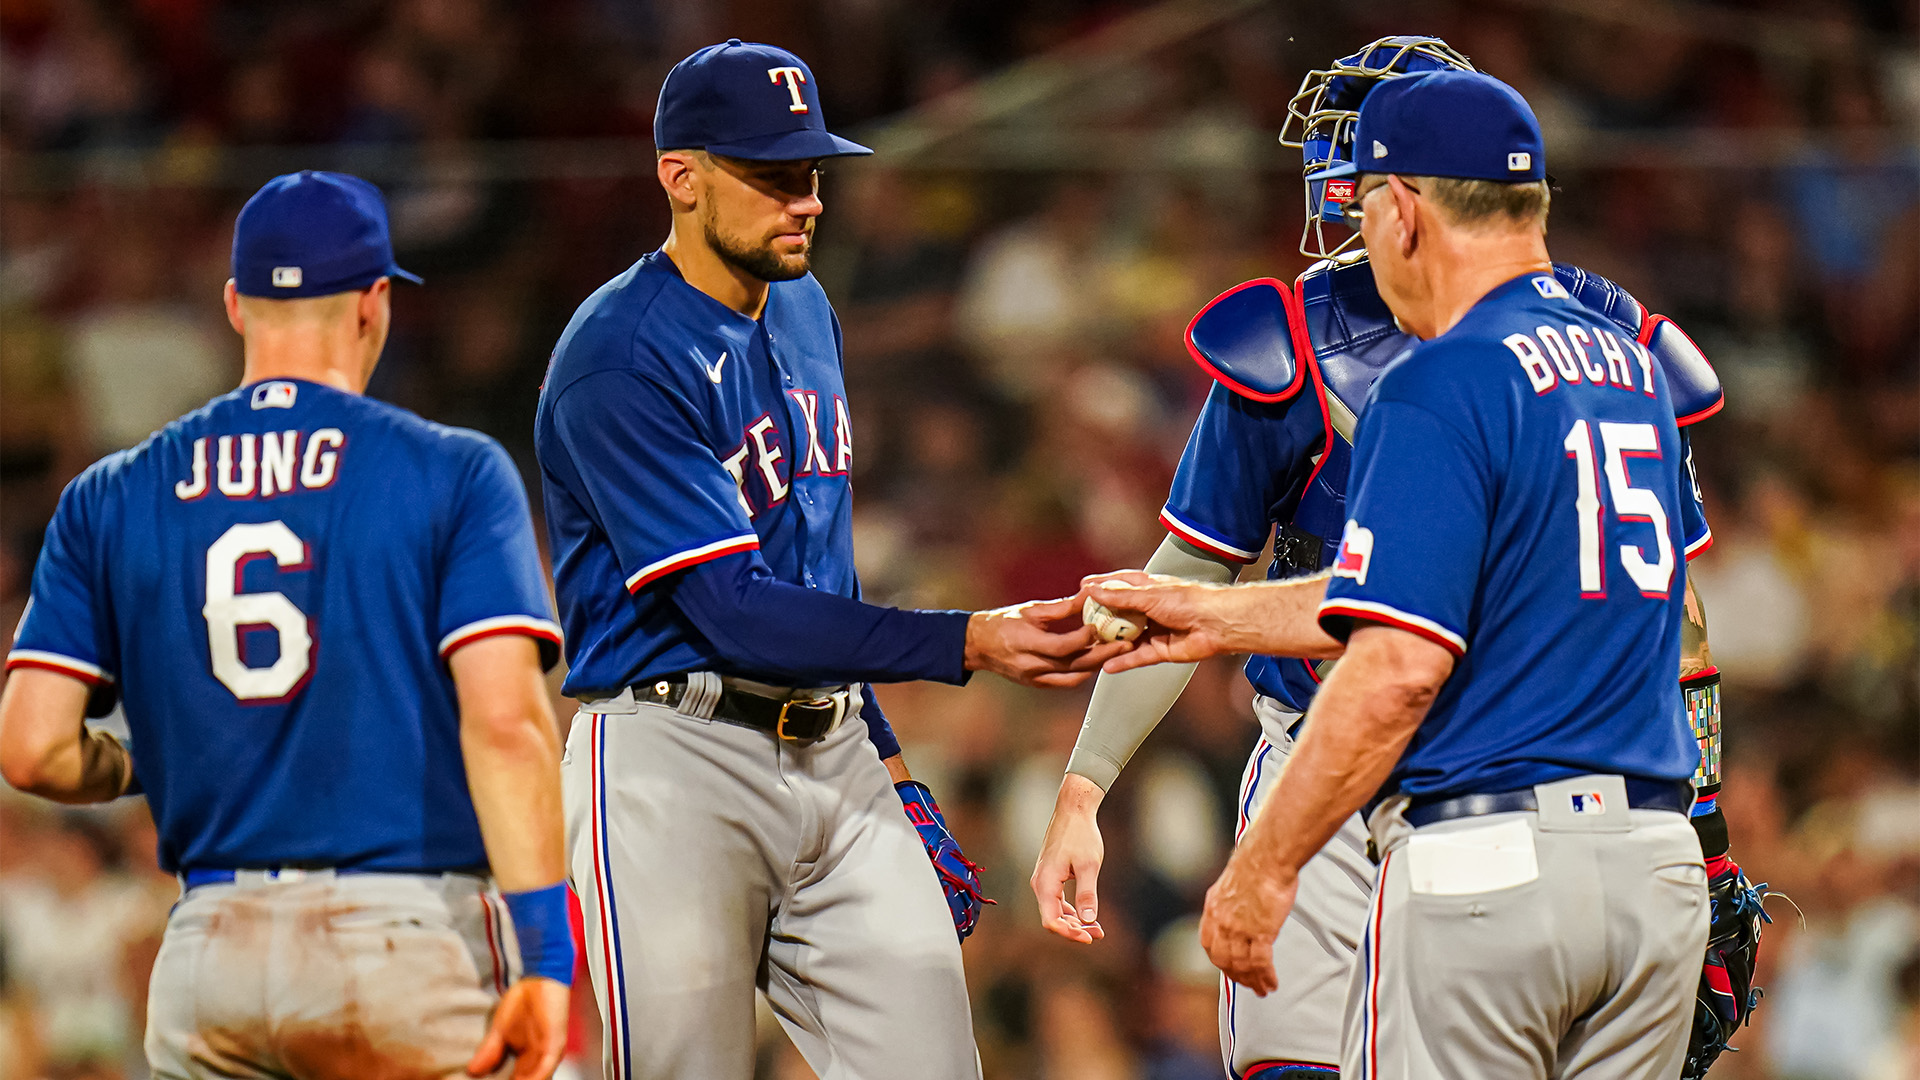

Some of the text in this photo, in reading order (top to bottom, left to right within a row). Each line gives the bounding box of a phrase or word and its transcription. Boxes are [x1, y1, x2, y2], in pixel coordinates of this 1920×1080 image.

[767, 67, 809, 114] T
[1502, 324, 1657, 400] BOCHY
[174, 427, 347, 501] JUNG
[721, 389, 854, 521] TEXA
[1563, 418, 1677, 600] 15
[202, 519, 319, 707] 6
